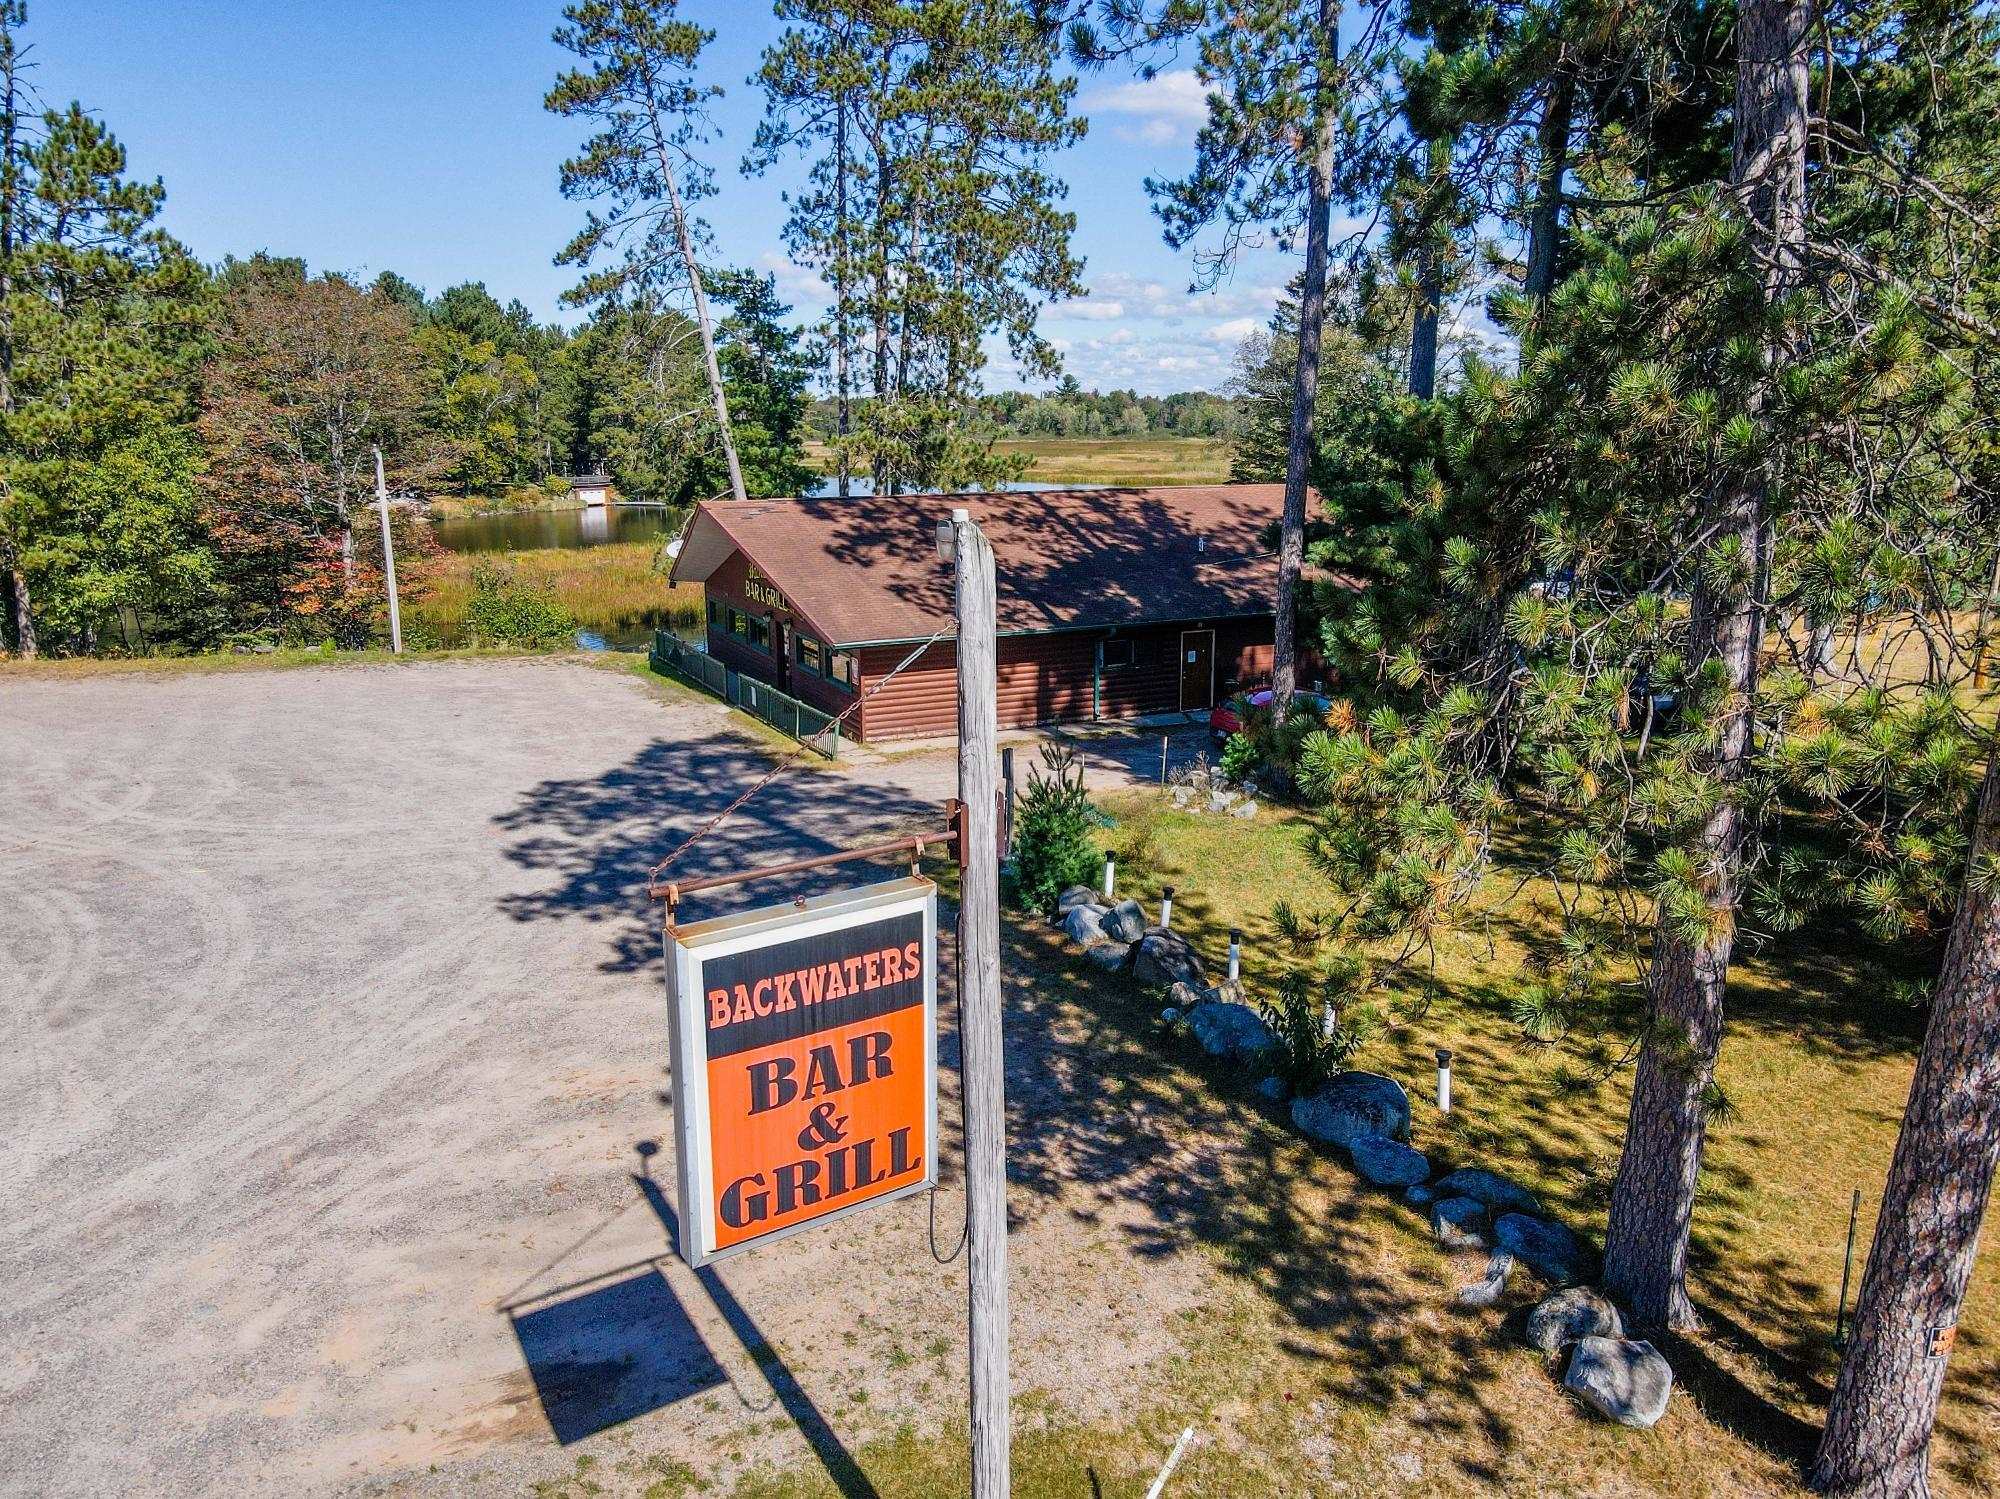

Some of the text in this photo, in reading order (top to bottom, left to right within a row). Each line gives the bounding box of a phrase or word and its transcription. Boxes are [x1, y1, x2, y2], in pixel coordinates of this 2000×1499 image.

[745, 580, 788, 612] BAR & GRILL
[708, 941, 921, 1029] BACKWATERS
[746, 1031, 894, 1116] BAR
[797, 1102, 849, 1151] &
[719, 1126, 922, 1228] GRILL
